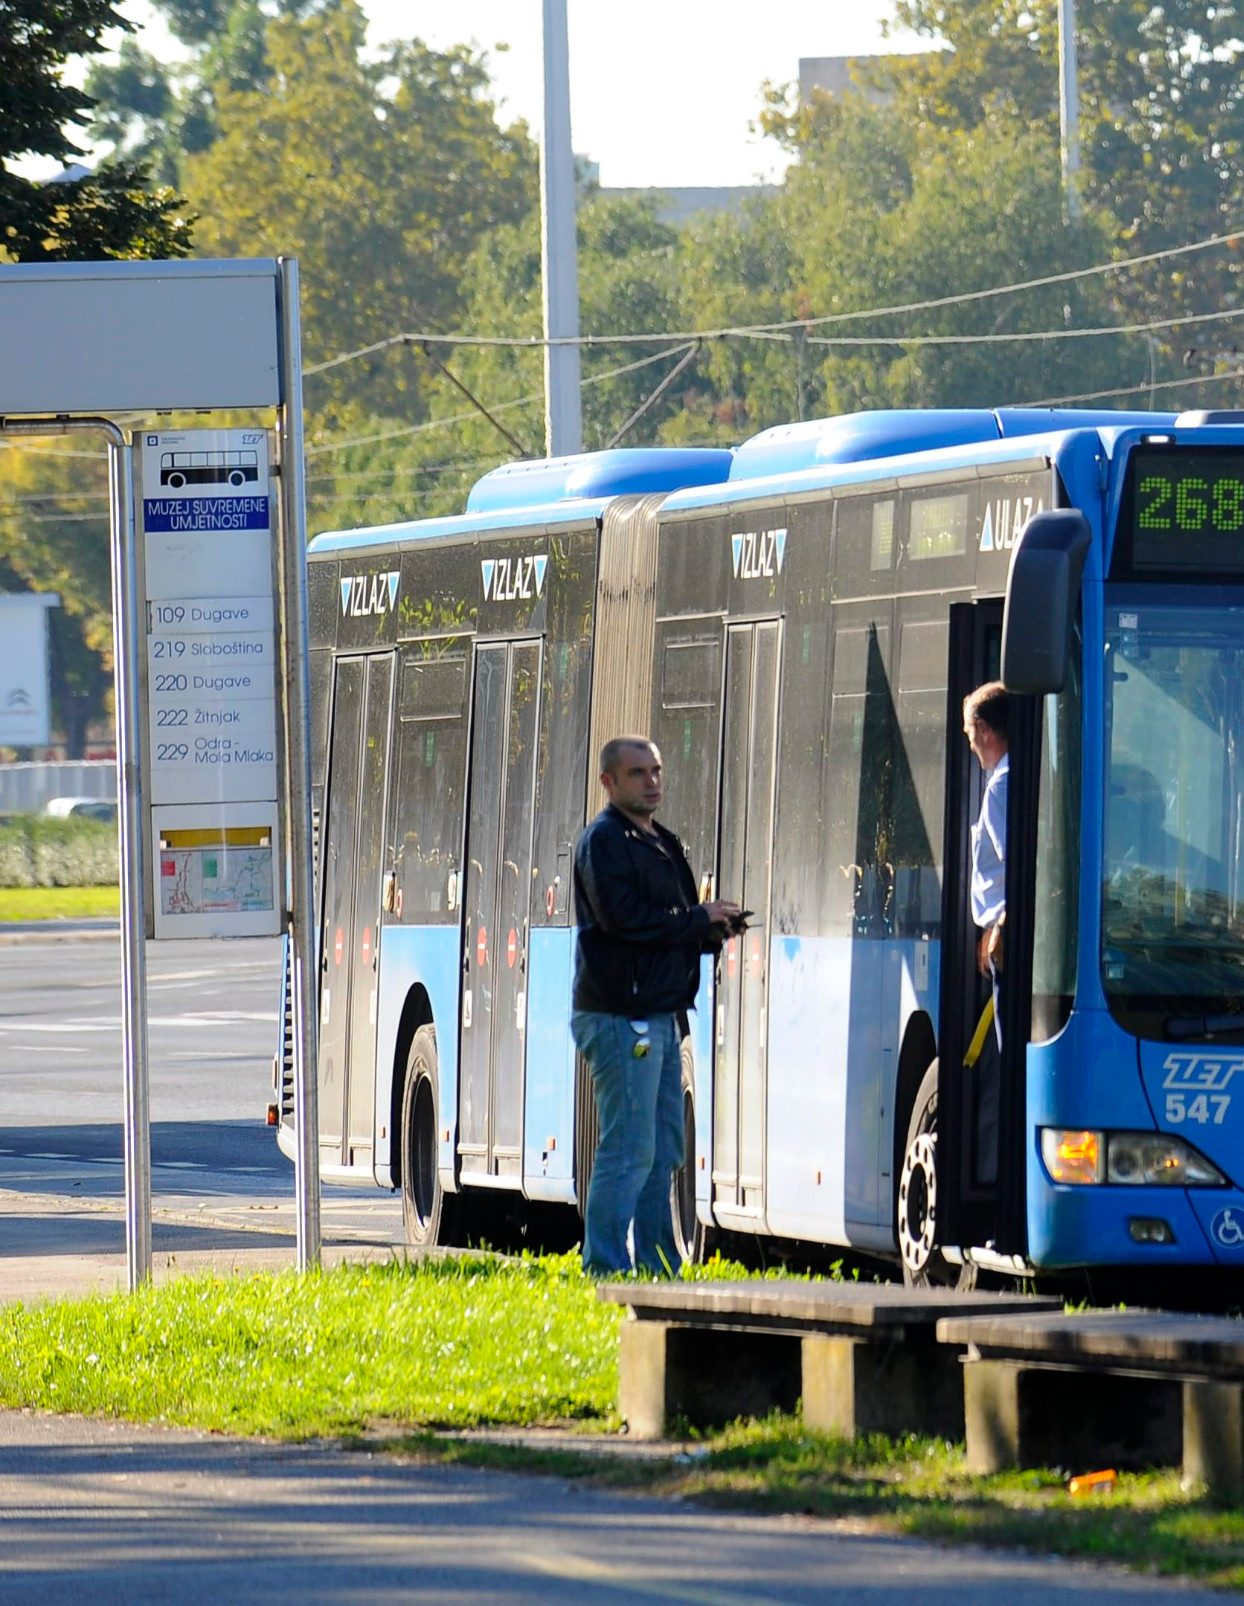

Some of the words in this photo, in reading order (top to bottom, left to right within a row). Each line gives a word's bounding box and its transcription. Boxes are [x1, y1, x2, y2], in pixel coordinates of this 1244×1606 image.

[148, 500, 189, 516] MUZEJ
[192, 499, 266, 514] SUVREMENE
[1139, 477, 1244, 530] 268
[170, 514, 248, 529] UMJETNOSTI
[741, 530, 775, 579] IZLAZ
[493, 556, 533, 601] IZLAZ
[350, 573, 388, 617] IZLAZ
[157, 606, 185, 623] 109
[191, 608, 249, 623] Dugave
[154, 641, 186, 658] 219
[191, 641, 263, 656] Sloboština
[155, 674, 187, 691] 220
[193, 676, 251, 691] Dugave
[157, 709, 188, 726] 222
[194, 708, 240, 725] Žitnjak
[157, 744, 189, 760] 229
[194, 737, 232, 750] Odra
[234, 749, 274, 763] Mlaka
[1165, 1094, 1232, 1125] 547
